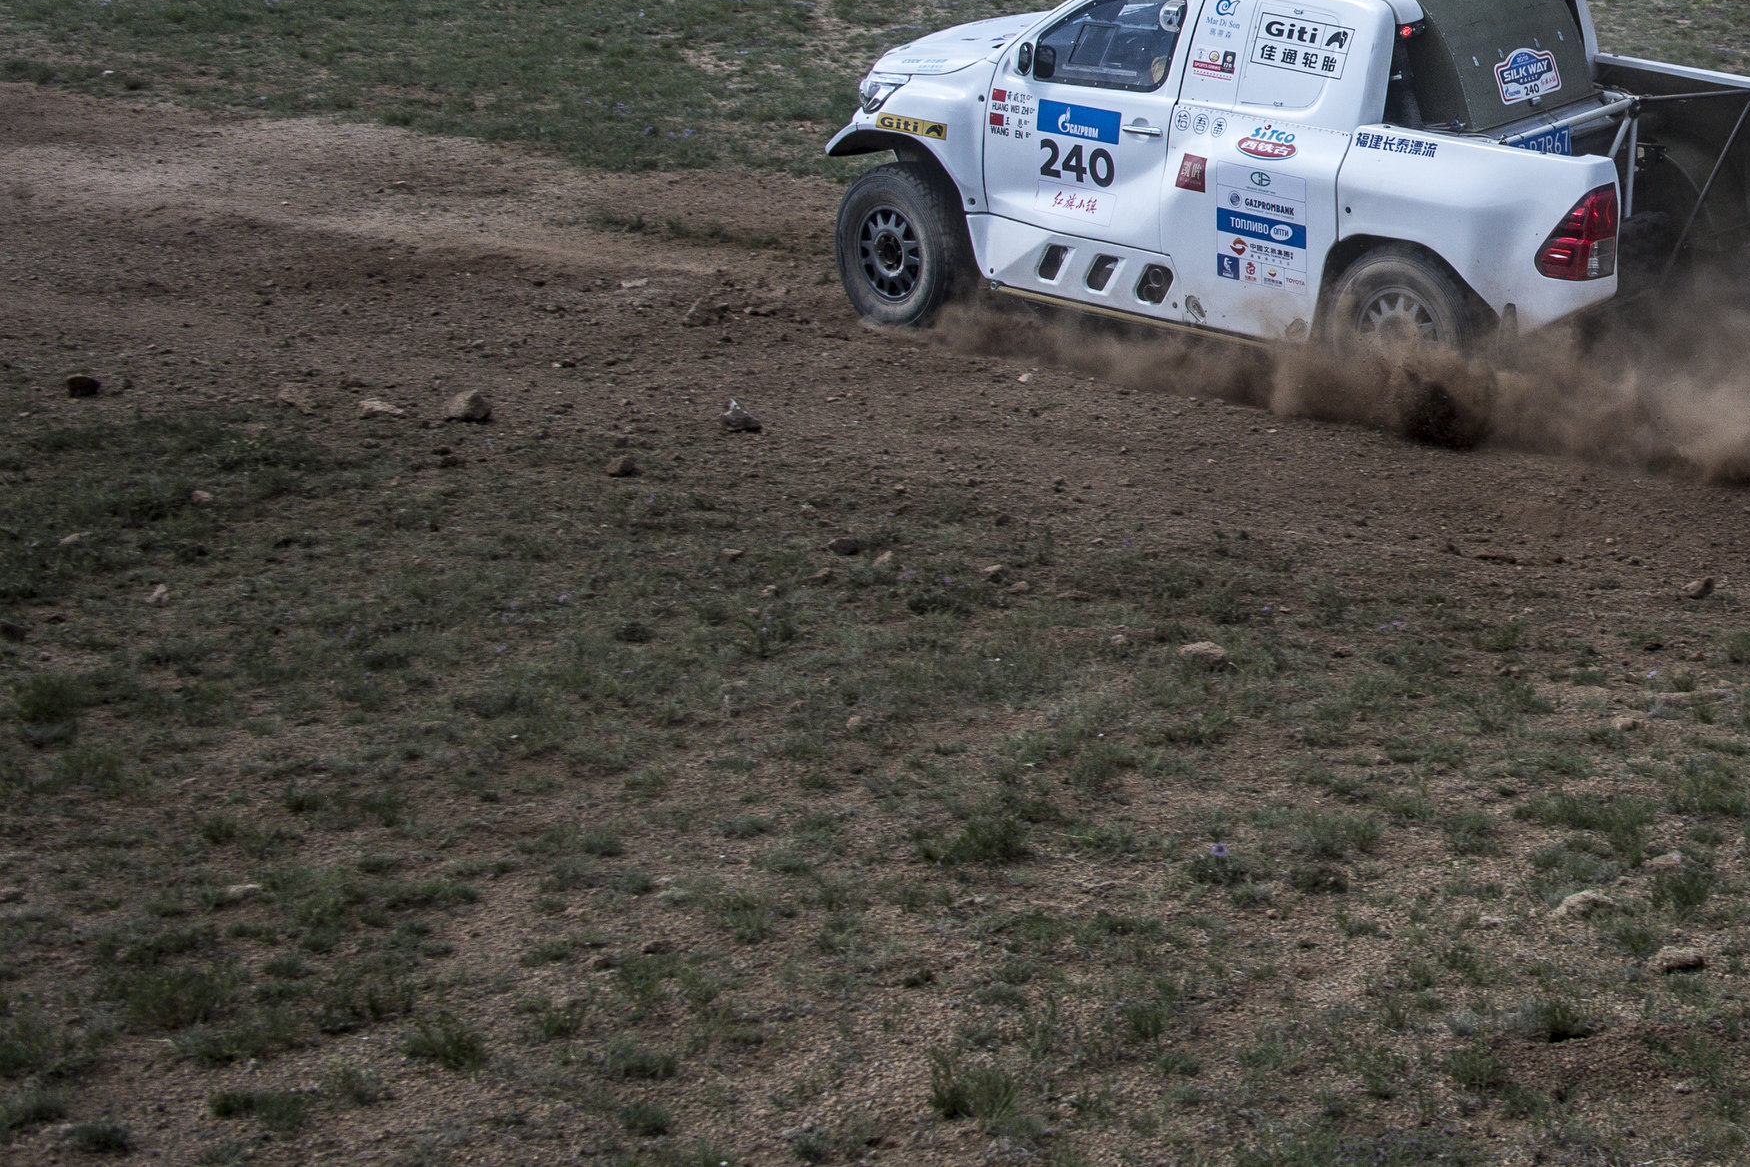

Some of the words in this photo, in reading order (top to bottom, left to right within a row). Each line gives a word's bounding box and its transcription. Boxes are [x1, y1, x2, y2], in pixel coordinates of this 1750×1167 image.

[1265, 21, 1319, 44] Giti
[1260, 44, 1337, 73] 佳通轮胎
[1503, 66, 1527, 82] SILK
[1527, 59, 1548, 74] WAY
[1524, 83, 1540, 96] 240
[992, 102, 1009, 112] HUANG
[1010, 104, 1020, 114] WEI
[880, 116, 919, 133] Giti
[990, 125, 1009, 137] WANG
[1014, 129, 1023, 139] EN
[1069, 122, 1099, 139] GAZPROM
[1356, 132, 1439, 158] 福建长泰漂流
[1040, 138, 1115, 187] 240
[1244, 197, 1295, 216] GAZPROMBANK
[1229, 216, 1269, 235] ТОПЛИВО
[1285, 277, 1306, 286] TOYOTA
